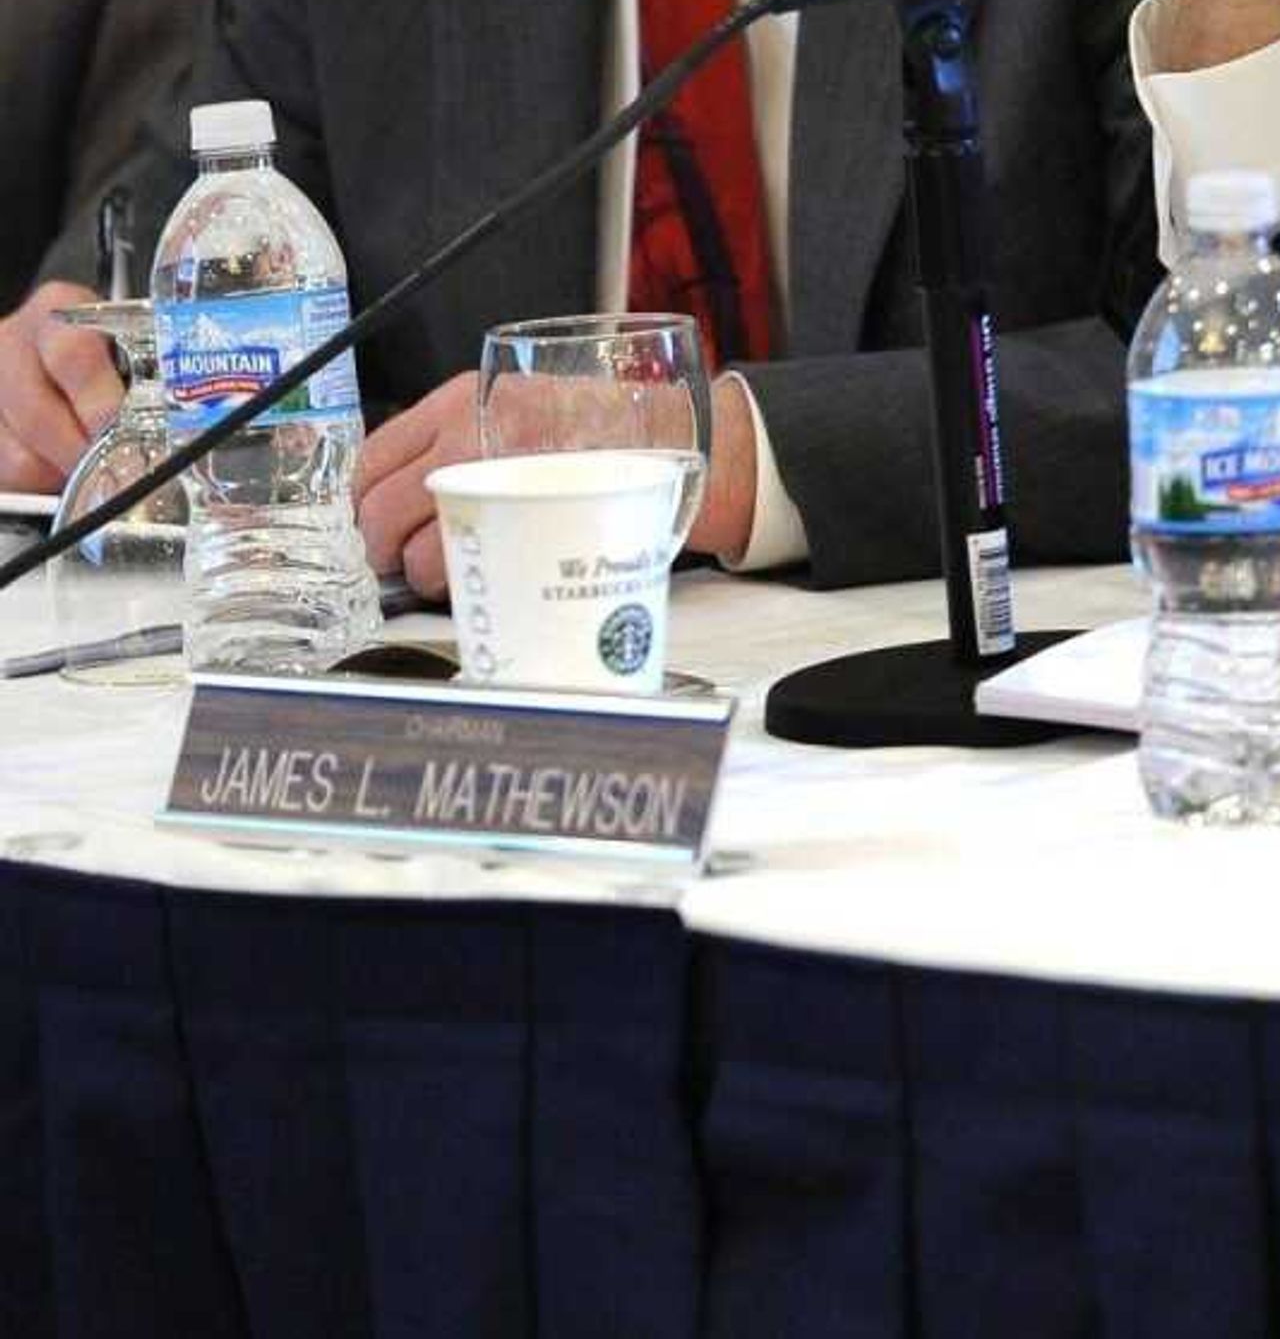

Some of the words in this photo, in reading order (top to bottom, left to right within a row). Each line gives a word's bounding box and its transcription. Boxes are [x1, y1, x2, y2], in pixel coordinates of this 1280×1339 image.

[181, 351, 271, 373] MOUNTAIN
[1206, 456, 1239, 480] ICE
[201, 747, 338, 812] JAMES
[355, 758, 391, 817] L.
[414, 761, 686, 835] MATHEWSON
